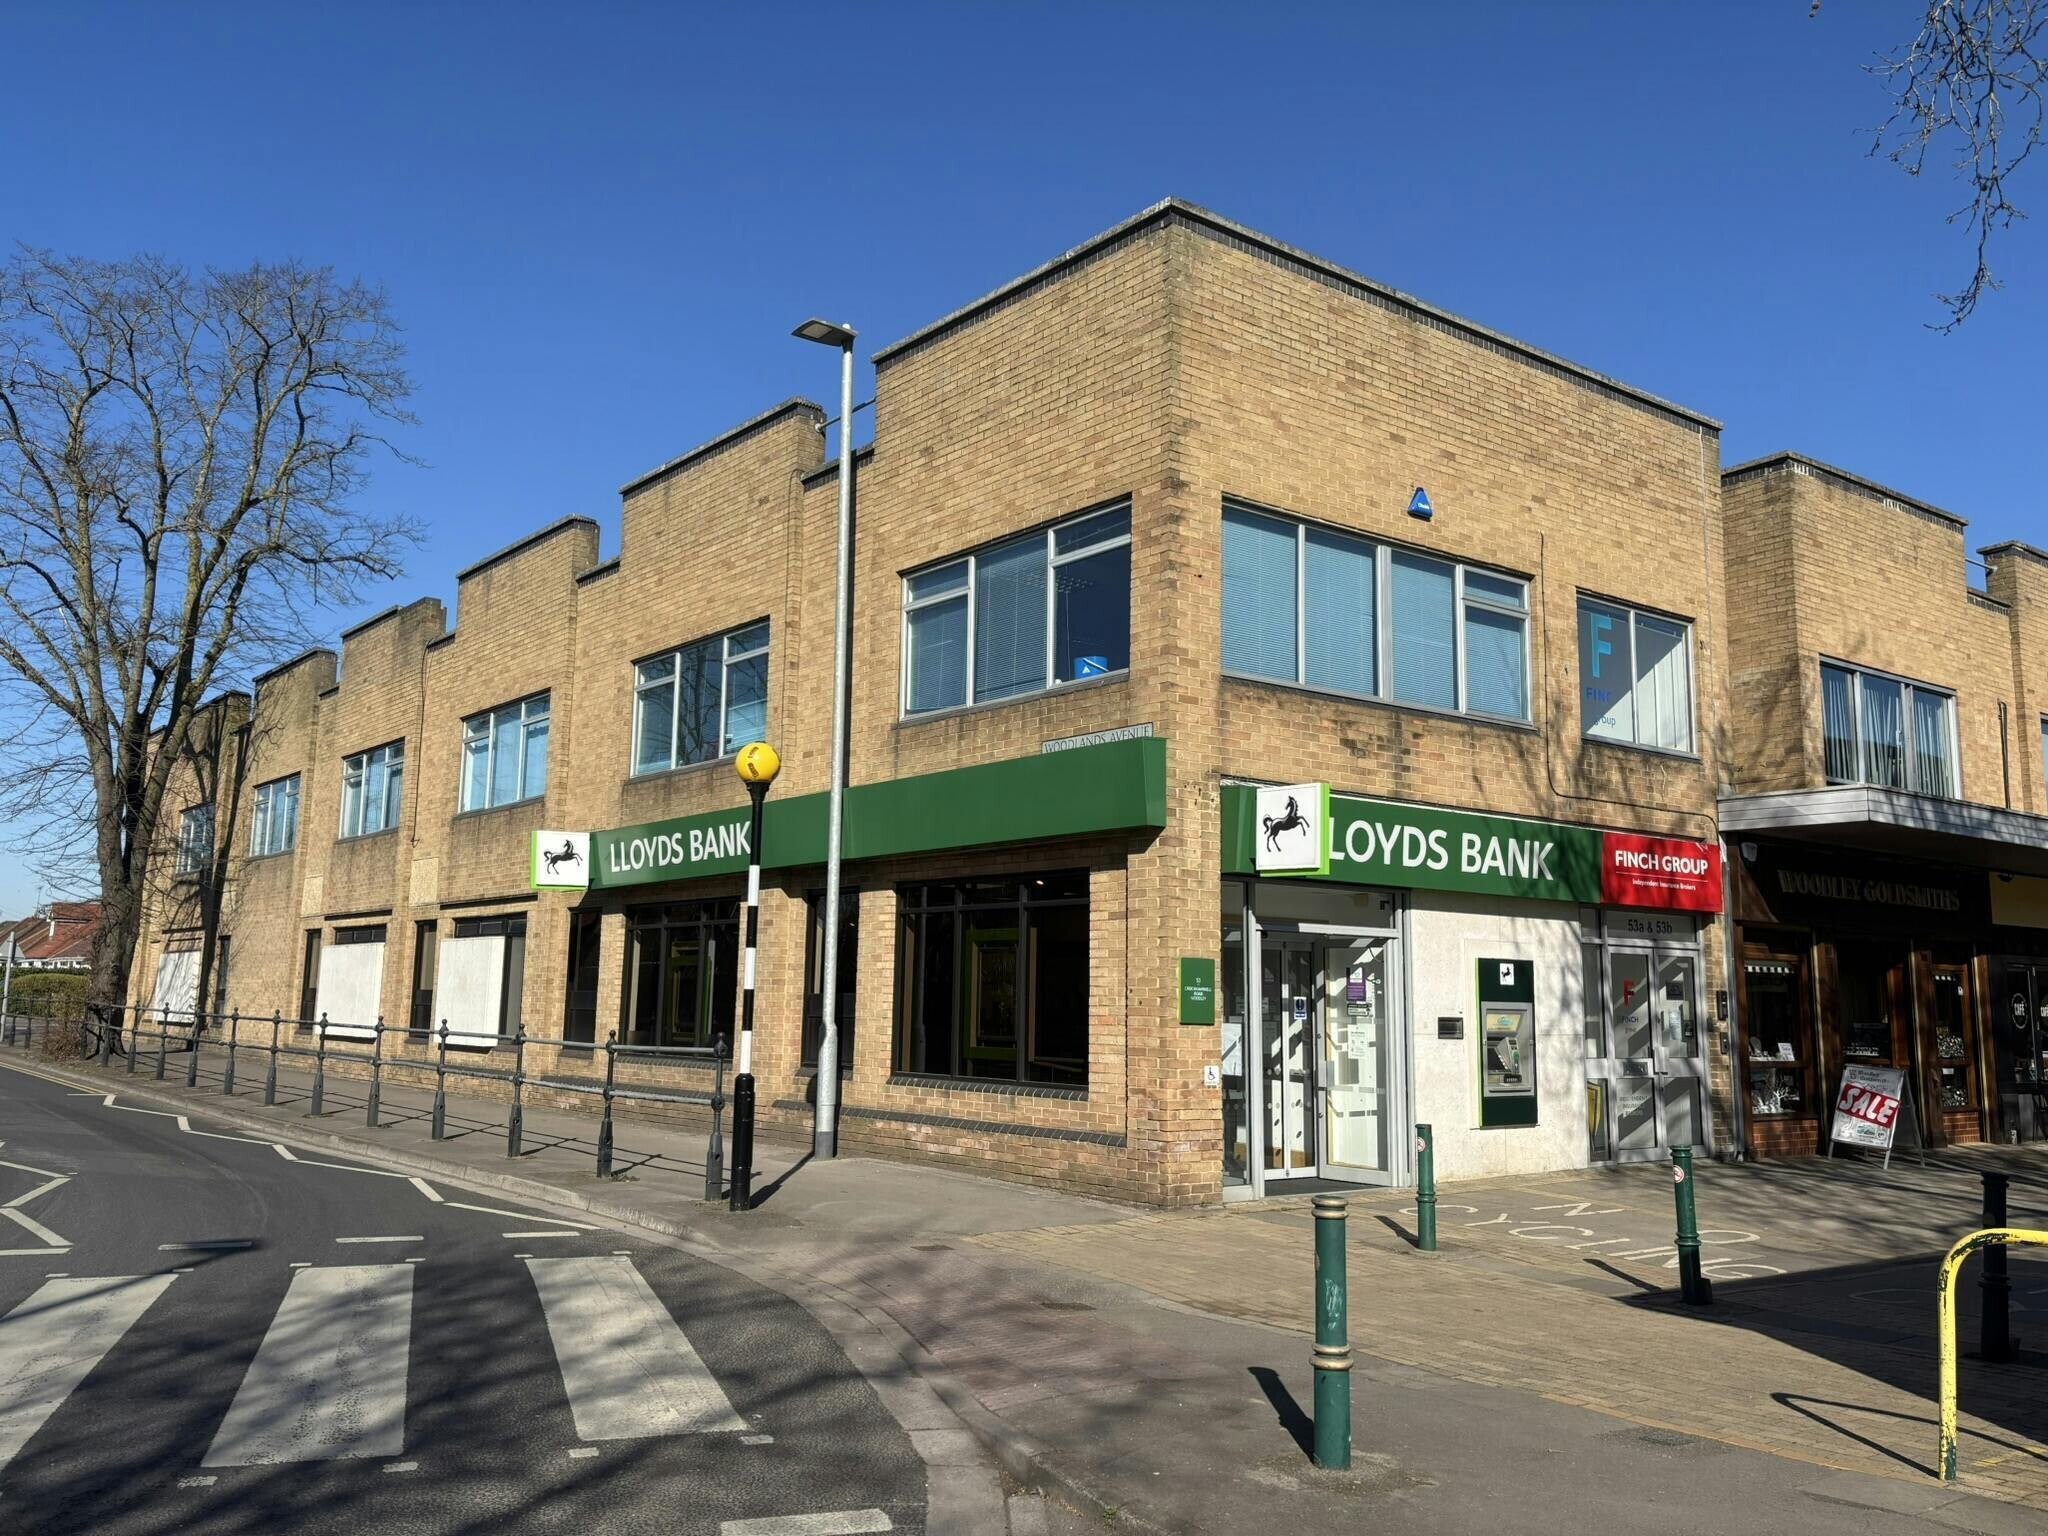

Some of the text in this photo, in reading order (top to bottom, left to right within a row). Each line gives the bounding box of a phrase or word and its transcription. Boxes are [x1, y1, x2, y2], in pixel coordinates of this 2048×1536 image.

[1591, 613, 1612, 678] F
[1586, 687, 1613, 702] FINC
[1044, 725, 1150, 753] WOODLANDS AVENUE
[611, 821, 751, 873] LLOYDS BANK
[1329, 816, 1555, 881] LOYDS BANK
[1615, 850, 1709, 875] FINCH GROUP
[1777, 869, 1960, 911] WOODLEY GOLDSMITHS
[1628, 919, 1673, 935] 53a & 53b
[1839, 1088, 1899, 1124] SALE
